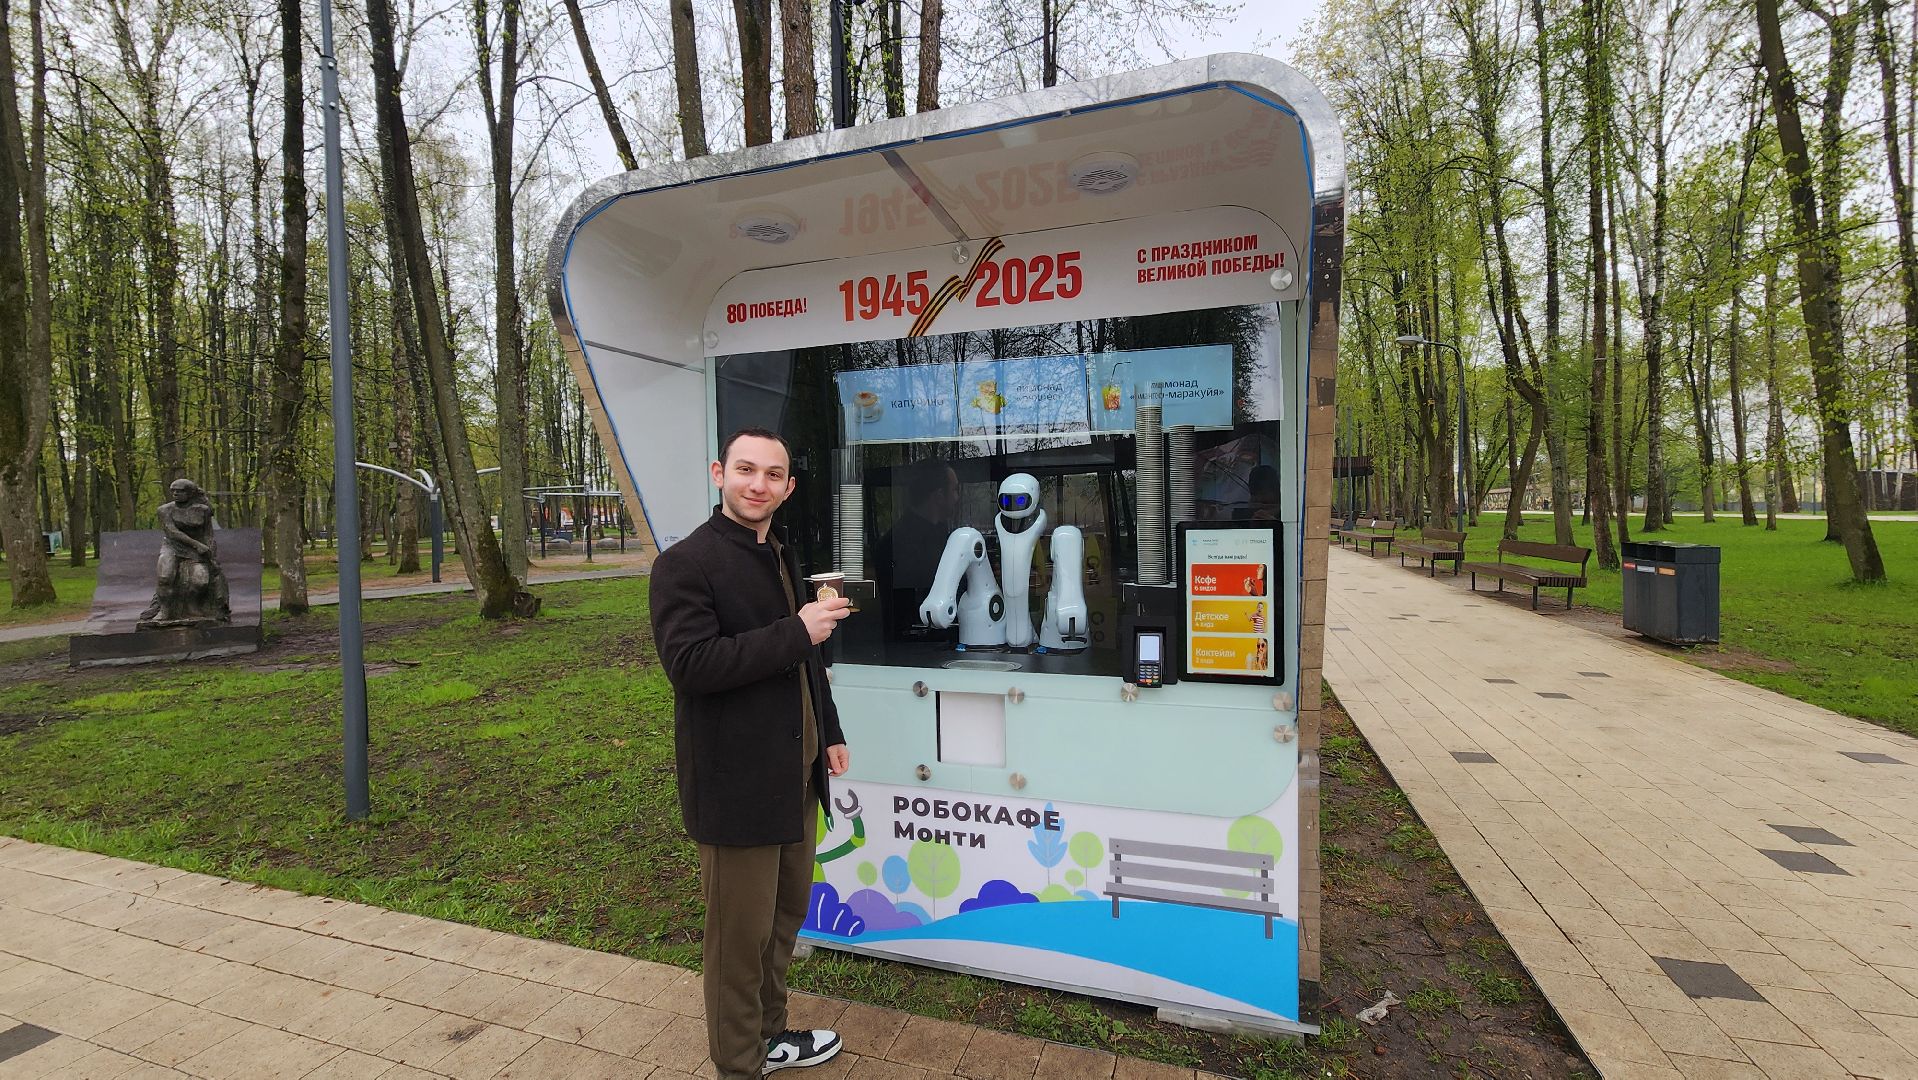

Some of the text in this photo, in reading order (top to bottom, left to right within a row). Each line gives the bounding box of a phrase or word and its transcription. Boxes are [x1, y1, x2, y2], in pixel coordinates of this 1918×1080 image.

[1137, 234, 1258, 264] С ПРАЗДНИКОМ
[1137, 252, 1285, 284] ВЕЛИКОЙ ПОБЕДЫ!
[838, 250, 1083, 322] 1945 2025
[726, 297, 808, 324] 80 ПОБЕДА!
[1194, 611, 1230, 621] Детское
[893, 795, 1061, 831] РОБОКАФЕ
[894, 820, 986, 849] Монти
